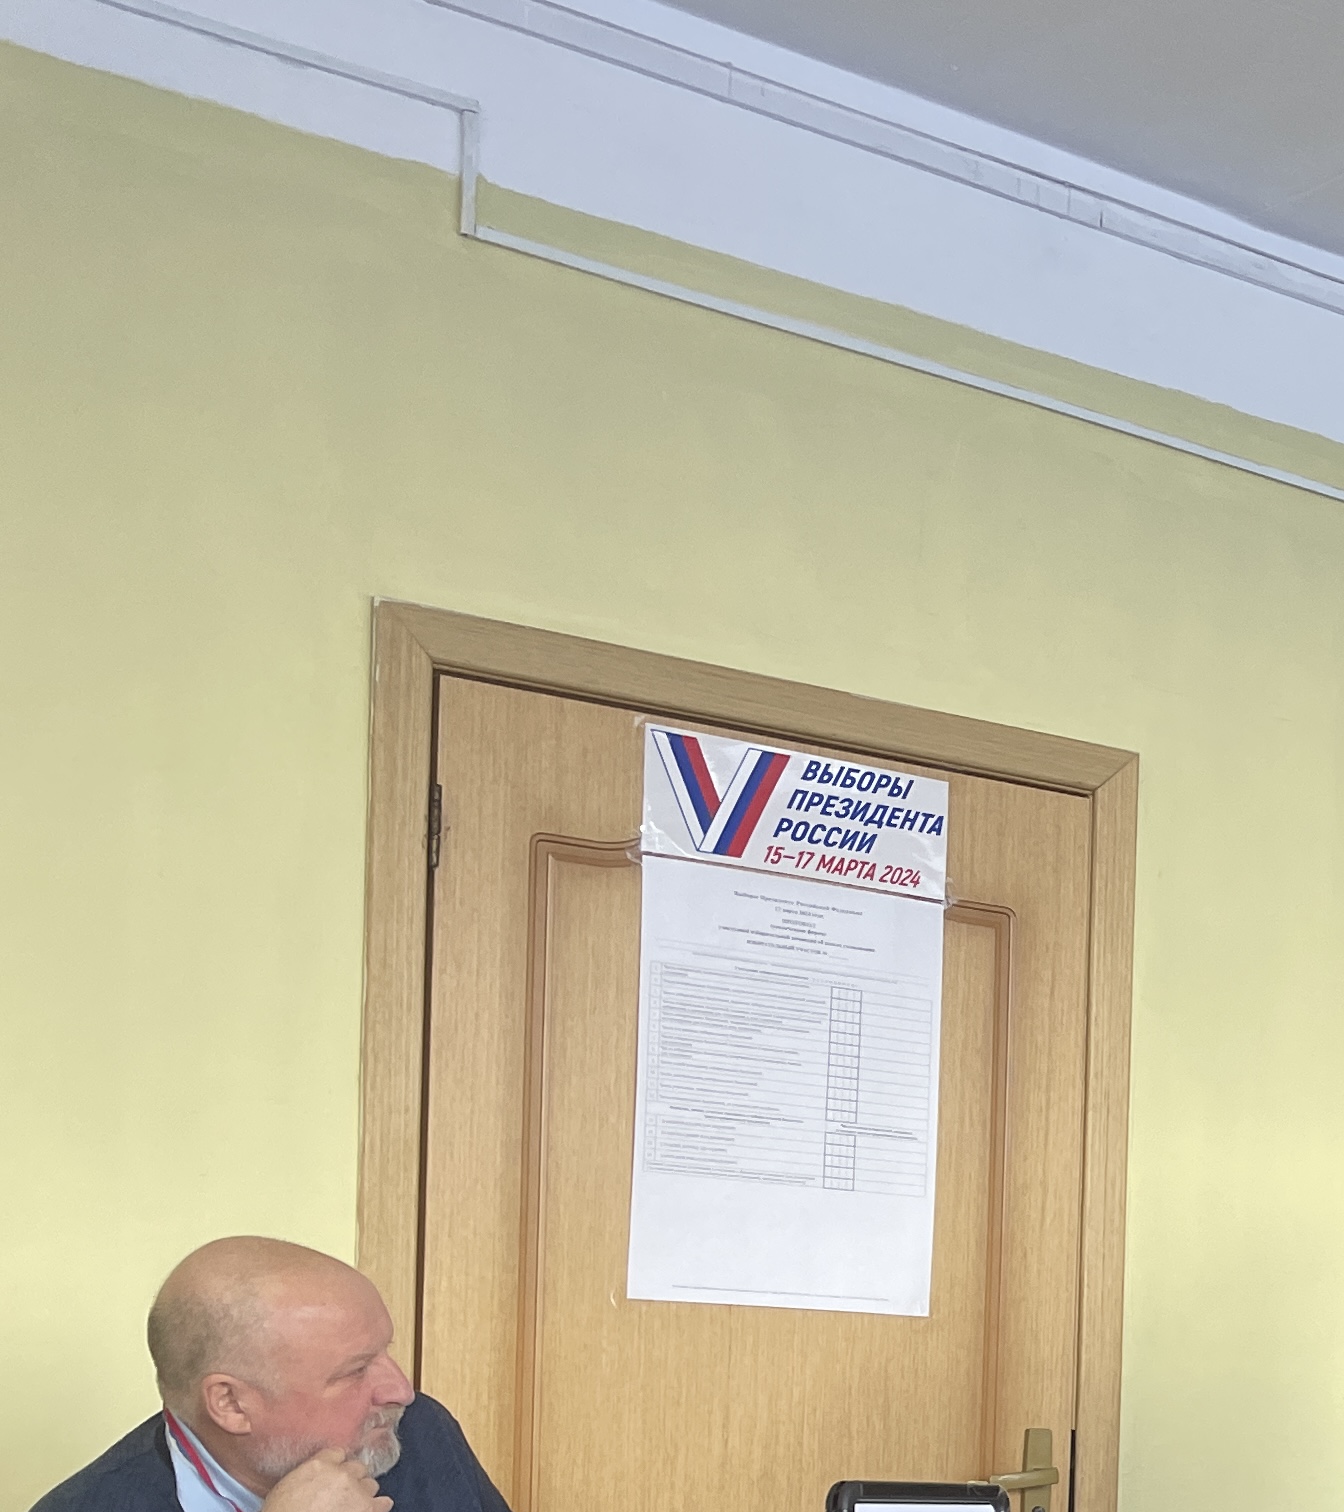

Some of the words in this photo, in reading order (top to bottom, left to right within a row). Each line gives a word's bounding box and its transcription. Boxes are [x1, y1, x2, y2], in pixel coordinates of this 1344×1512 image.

[801, 760, 914, 800] ВЫБОРЫ
[787, 788, 945, 836] ПРЕЗИДЕНТА
[773, 817, 878, 854] РОССИИ
[815, 853, 877, 881] МАРТА
[878, 865, 921, 888] 2024
